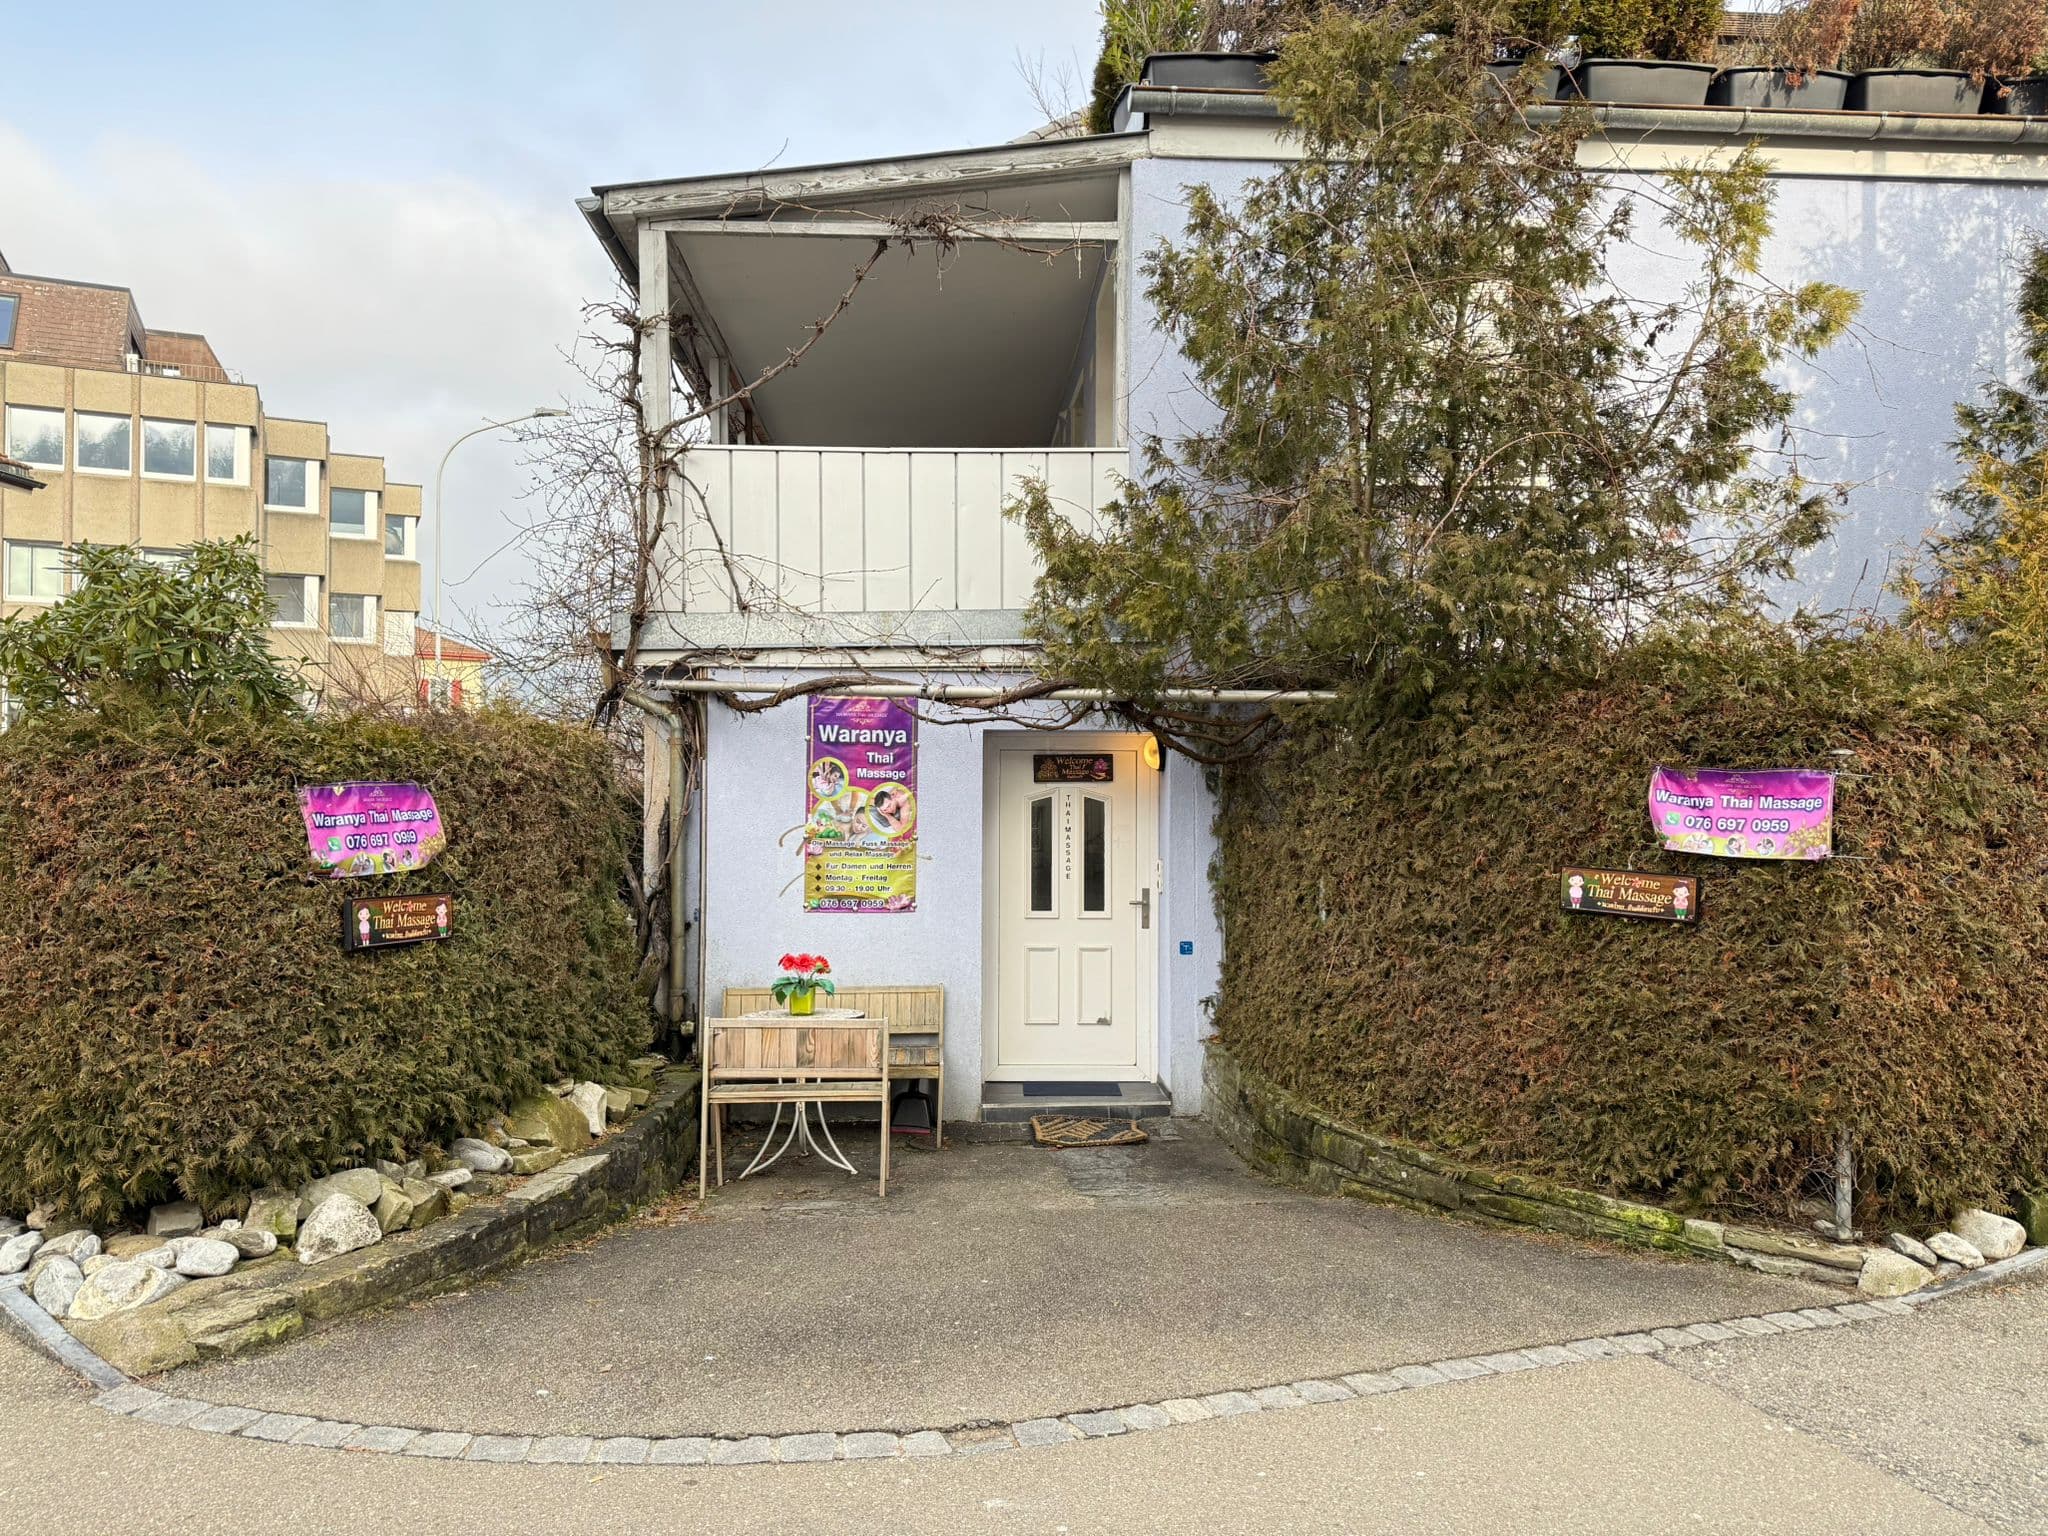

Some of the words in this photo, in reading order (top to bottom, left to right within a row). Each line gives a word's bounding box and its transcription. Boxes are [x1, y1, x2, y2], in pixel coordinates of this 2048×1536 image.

[818, 725, 907, 747] Waranya
[866, 752, 894, 763] Thai
[857, 768, 906, 780] Massage
[1655, 790, 1714, 809] Waranya
[1720, 795, 1753, 809] Thai
[1759, 796, 1823, 811] Massage
[312, 812, 366, 827] Waranya
[368, 810, 389, 823] Thai
[1685, 816, 1712, 830] 076
[1717, 818, 1746, 831] 697
[1752, 819, 1789, 832] 0959
[346, 835, 368, 849] 076
[370, 834, 389, 847] 697
[825, 874, 853, 882] Montag
[861, 874, 888, 882] Freitag
[1587, 884, 1615, 899] Thai
[1618, 887, 1673, 907] Massage
[373, 913, 395, 930] Thai
[397, 913, 436, 929] Massage
